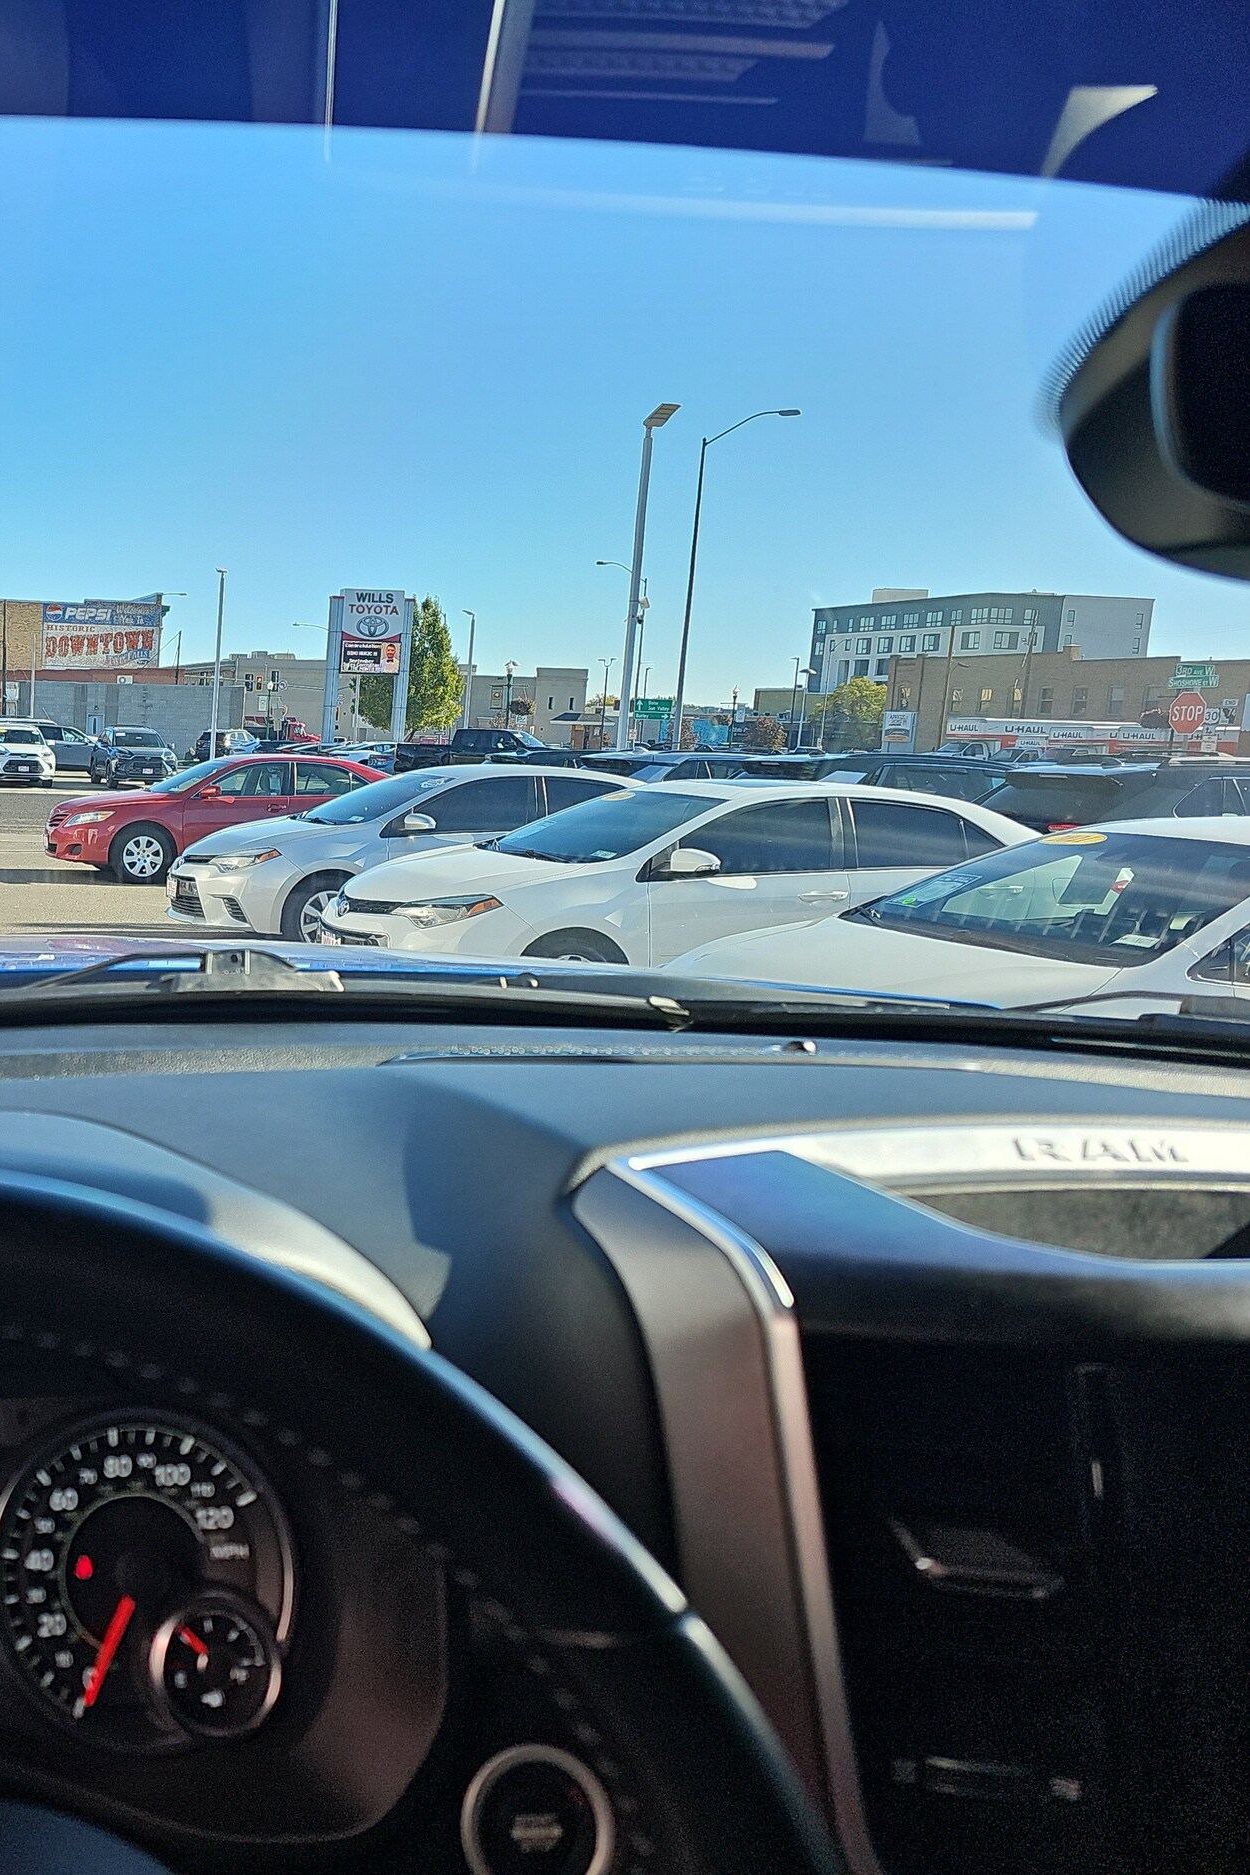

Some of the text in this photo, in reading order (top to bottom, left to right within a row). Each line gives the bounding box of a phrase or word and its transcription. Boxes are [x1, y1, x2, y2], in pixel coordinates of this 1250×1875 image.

[356, 592, 394, 604] WILLS
[64, 607, 112, 621] PEPSI
[348, 604, 399, 616] TOYOTA
[46, 625, 96, 633] HISTORIC
[45, 629, 155, 658] DOWNTOWN
[1177, 665, 1193, 675] 3RD
[1205, 665, 1216, 676] W
[1168, 678, 1202, 688] SHOSHONE
[1209, 676, 1219, 687] W
[1171, 705, 1204, 721] STOP
[1205, 711, 1219, 721] 30
[950, 724, 978, 732] U-HAUL
[1004, 725, 1047, 734] U-HAUL
[1052, 731, 1083, 739] U-HAUL
[1122, 731, 1156, 740] U-HAUL
[1012, 1136, 1190, 1163] RAM
